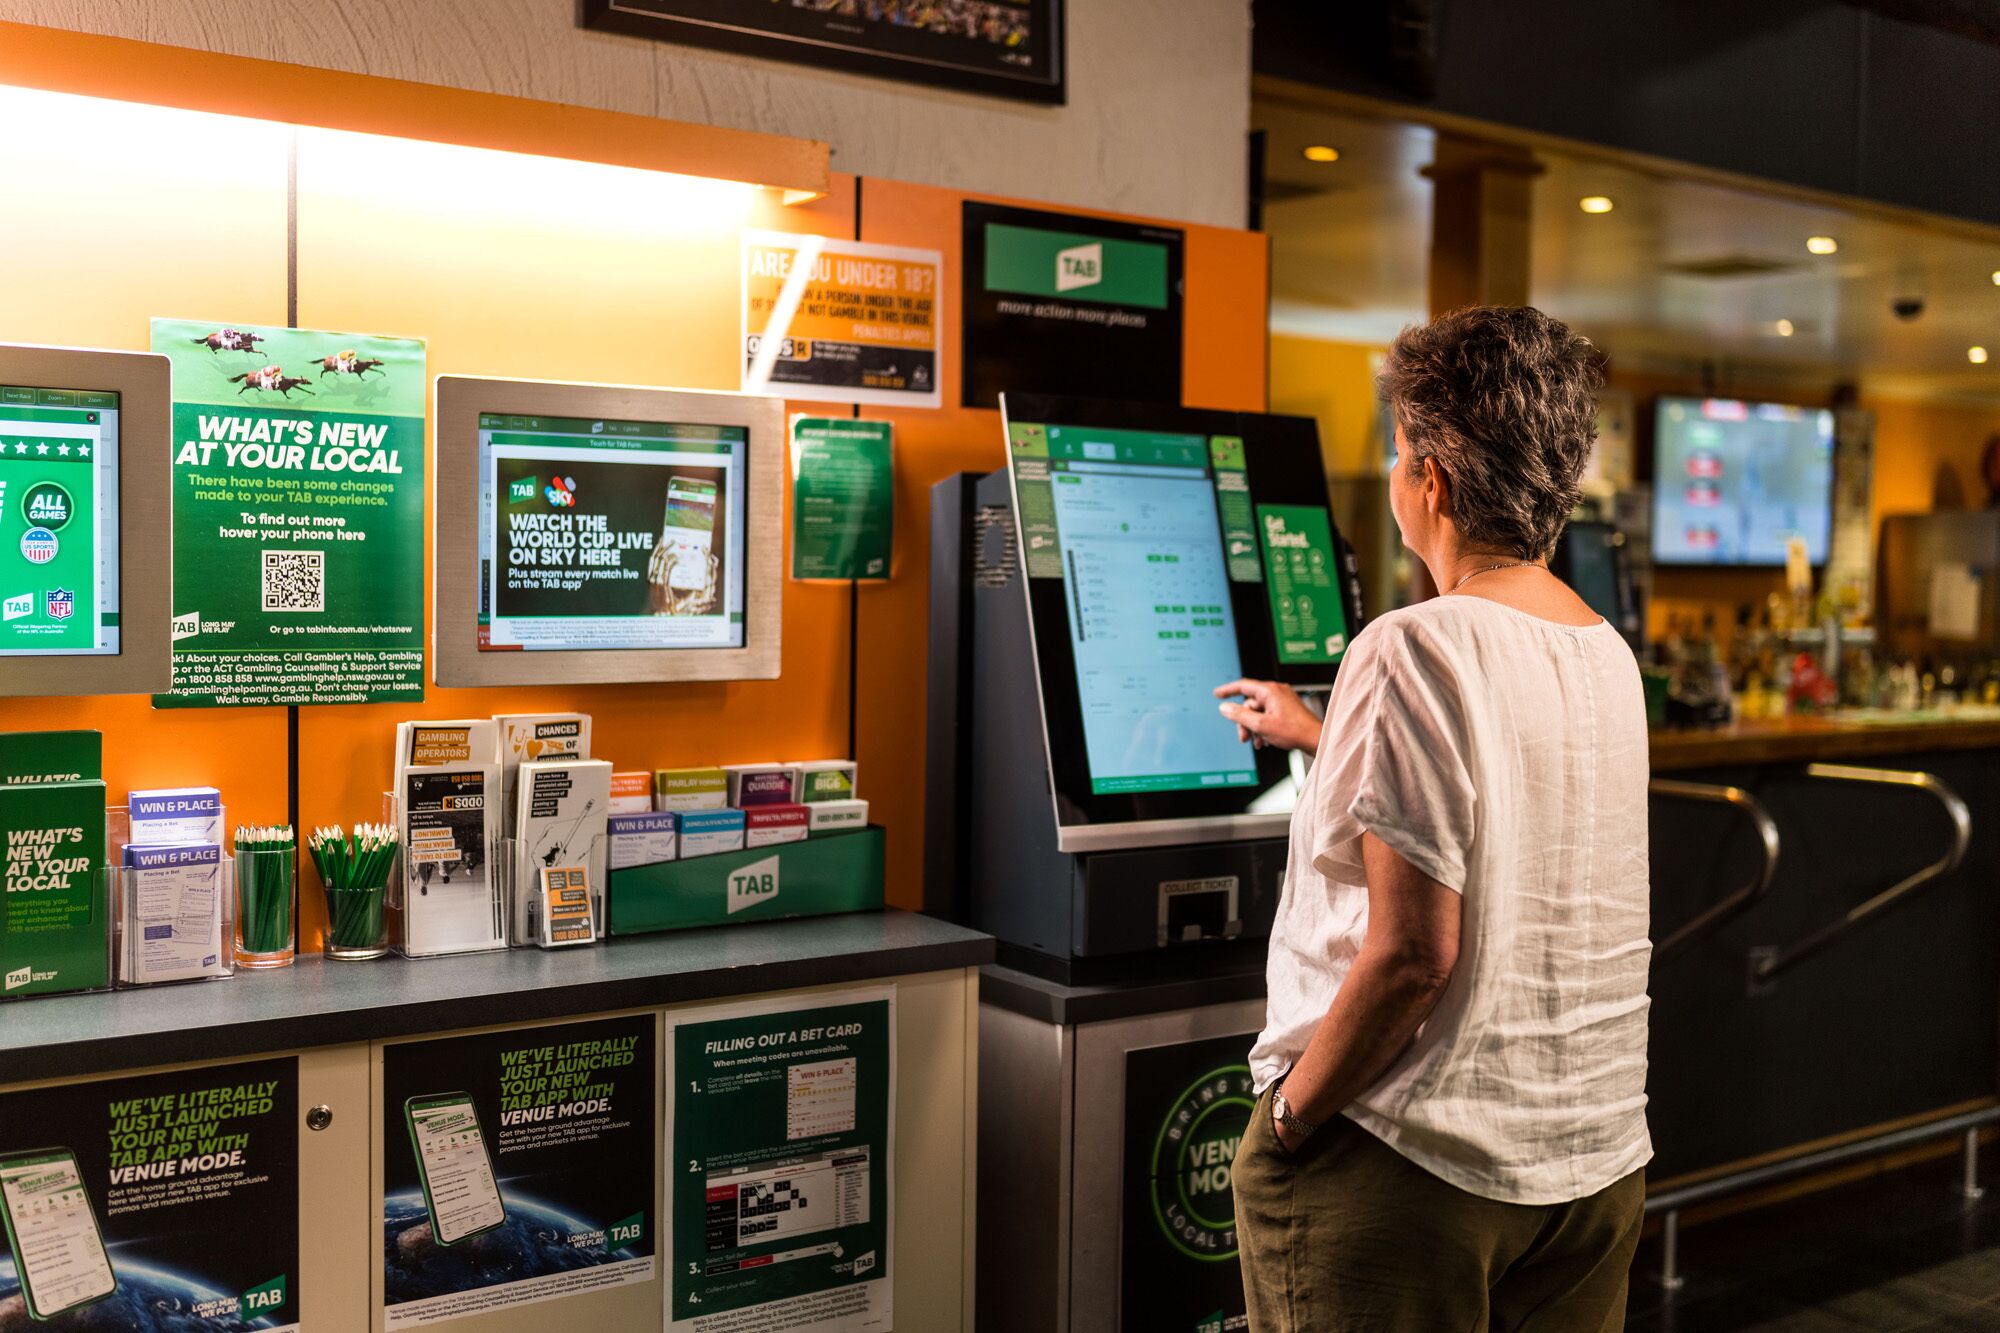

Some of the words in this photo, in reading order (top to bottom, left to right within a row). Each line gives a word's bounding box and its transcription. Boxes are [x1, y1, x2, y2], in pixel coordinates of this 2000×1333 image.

[752, 250, 790, 277] ARE
[837, 260, 897, 290] UNDER
[904, 268, 933, 293] 18?
[1064, 258, 1096, 278] TAB
[997, 301, 1030, 314] more
[1033, 304, 1072, 318] action
[1076, 309, 1105, 322] more
[1106, 310, 1147, 328] places
[198, 415, 314, 445] WHAT'S
[319, 422, 388, 448] NEW
[175, 441, 218, 465] AT
[223, 442, 305, 470] YOUR
[310, 447, 403, 474] LOCAL
[188, 474, 227, 487] There
[230, 476, 263, 488] have
[266, 477, 300, 489] been
[304, 481, 337, 490] some
[341, 480, 394, 494] changes
[512, 484, 534, 496] TAB
[30, 494, 66, 511] ALL
[195, 490, 234, 501] made
[238, 492, 251, 501] to
[255, 493, 284, 505] your
[287, 492, 312, 504] TAB
[316, 493, 388, 506] experience.
[548, 490, 574, 504] SKY
[29, 510, 66, 520] GAMES
[240, 512, 256, 524] To
[259, 512, 285, 526] find
[288, 514, 310, 526] out
[313, 517, 346, 527] more
[509, 513, 572, 531] WATCH
[576, 514, 608, 532] THE
[220, 526, 258, 539] hover
[260, 529, 290, 542] your
[293, 529, 334, 542] phone
[337, 530, 366, 541] here
[509, 530, 576, 549] WORLD
[579, 532, 614, 550] CUP
[618, 532, 653, 550] LIVE
[509, 548, 538, 565] ON
[540, 548, 576, 566] SKY
[580, 549, 621, 566] HERE
[508, 568, 528, 578] Plus
[530, 569, 563, 579] stream
[564, 570, 590, 580] every
[592, 568, 622, 579] match
[623, 568, 640, 579] live
[508, 580, 521, 589] on
[524, 579, 540, 588] the
[542, 579, 560, 589] TAB
[7, 602, 30, 612] TAB
[50, 602, 71, 616] NFL
[270, 626, 280, 634] Or
[283, 626, 294, 635] go
[296, 626, 304, 634] to
[306, 625, 413, 634] tabinfo.com.au/whatsnew
[189, 675, 213, 684] 1800
[215, 674, 232, 683] 858
[235, 674, 252, 683] 858
[315, 684, 340, 692] Don't
[342, 683, 369, 691] chase
[371, 684, 391, 693] your
[392, 682, 421, 691] losses.
[216, 696, 240, 704] Walk
[242, 696, 270, 705] away.
[272, 694, 310, 703] Gamble
[312, 692, 368, 702] Responsibly.
[419, 732, 465, 742] GAMBLING
[538, 724, 577, 736] CHANCES
[417, 748, 467, 758] OPERATORS
[566, 740, 578, 749] OF
[140, 803, 165, 814] WIN
[167, 802, 176, 812] &
[178, 800, 214, 811] PLACE
[455, 797, 483, 808] ODDS
[616, 821, 635, 831] WIN
[637, 821, 644, 830] &
[646, 819, 673, 829] PLACE
[8, 827, 83, 846] WHAT'S
[6, 845, 55, 862] NEW
[140, 854, 166, 866] WIN
[169, 853, 178, 863] &
[181, 850, 217, 861] PLACE
[5, 861, 36, 877] AT
[38, 858, 89, 874] YOUR
[7, 876, 71, 892] LOCAL
[734, 874, 774, 895] TAB
[1164, 882, 1201, 894] COLLECT
[1204, 879, 1233, 891] TICKET
[554, 931, 567, 940] 1800
[568, 930, 579, 939] 858
[9, 974, 28, 983] TAB
[705, 1036, 755, 1054] FILLING
[758, 1033, 786, 1047] OUT
[788, 1031, 797, 1043] A
[800, 1028, 824, 1042] BET
[826, 1023, 862, 1038] CARD
[500, 1046, 555, 1066] WE'VE
[557, 1036, 639, 1059] LITERALLY
[713, 1059, 735, 1068] When
[737, 1055, 767, 1065] meeting
[768, 1052, 790, 1061] codes
[805, 1044, 849, 1056] unavailable.
[500, 1062, 542, 1082] JUST
[545, 1051, 635, 1075] LAUNCHED
[500, 1077, 547, 1096] YOUR
[551, 1071, 590, 1090] NEW
[110, 1095, 175, 1118] WE'VE
[178, 1080, 278, 1109] LITERALLY
[501, 1095, 531, 1111] TAB
[534, 1089, 568, 1107] APP
[572, 1082, 614, 1100] WITH
[108, 1114, 160, 1135] JUST
[164, 1098, 273, 1127] LAUNCHED
[501, 1106, 555, 1126] VENUE
[558, 1098, 612, 1118] MODE.
[1168, 1079, 1228, 1140] BRING
[110, 1129, 166, 1151] YOUR
[171, 1122, 220, 1142] NEW
[110, 1149, 147, 1168] TAB
[151, 1142, 192, 1162] APP
[197, 1133, 249, 1154] WITH
[109, 1161, 177, 1185] VENUE
[180, 1151, 246, 1175] MODE.
[611, 1224, 640, 1241] TAB
[1166, 1204, 1217, 1248] LOCAL
[856, 1257, 873, 1268] TAB
[246, 1290, 282, 1308] TAB
